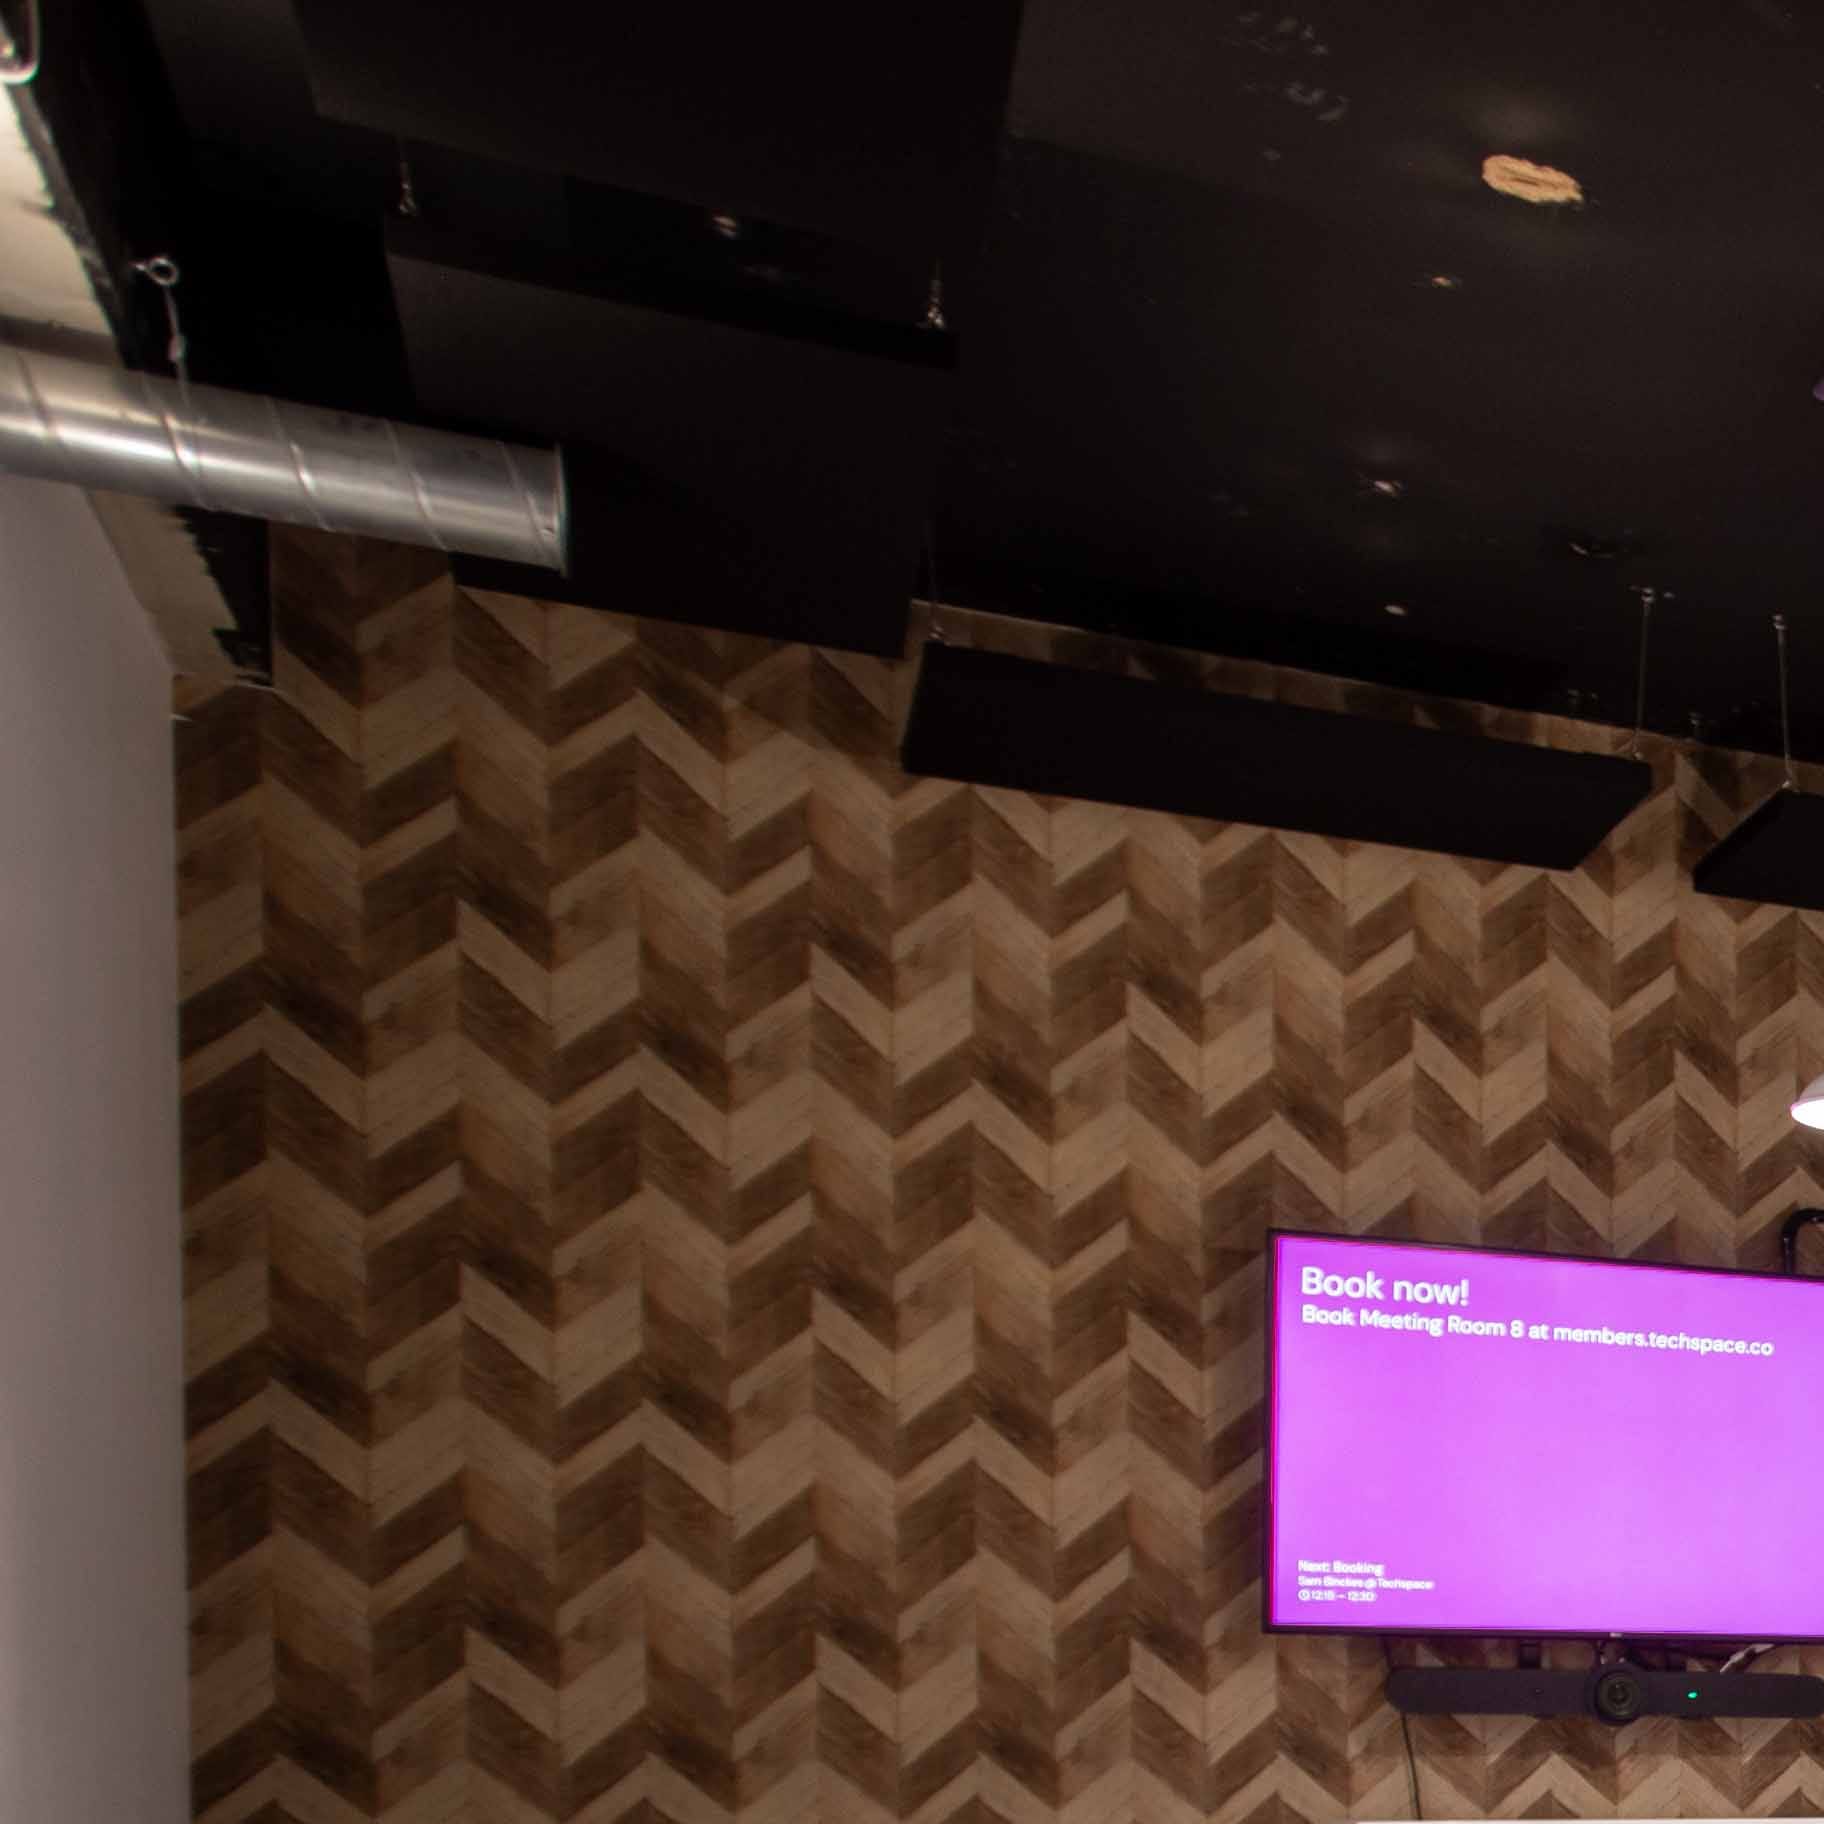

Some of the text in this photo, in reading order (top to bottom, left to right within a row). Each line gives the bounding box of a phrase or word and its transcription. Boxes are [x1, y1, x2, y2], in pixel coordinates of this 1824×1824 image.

[1301, 1266, 1470, 1306] Book now!
[1302, 1304, 1774, 1356] Book Meeting Room 8 at members.techspace.co
[1333, 1560, 1385, 1577] Booking
